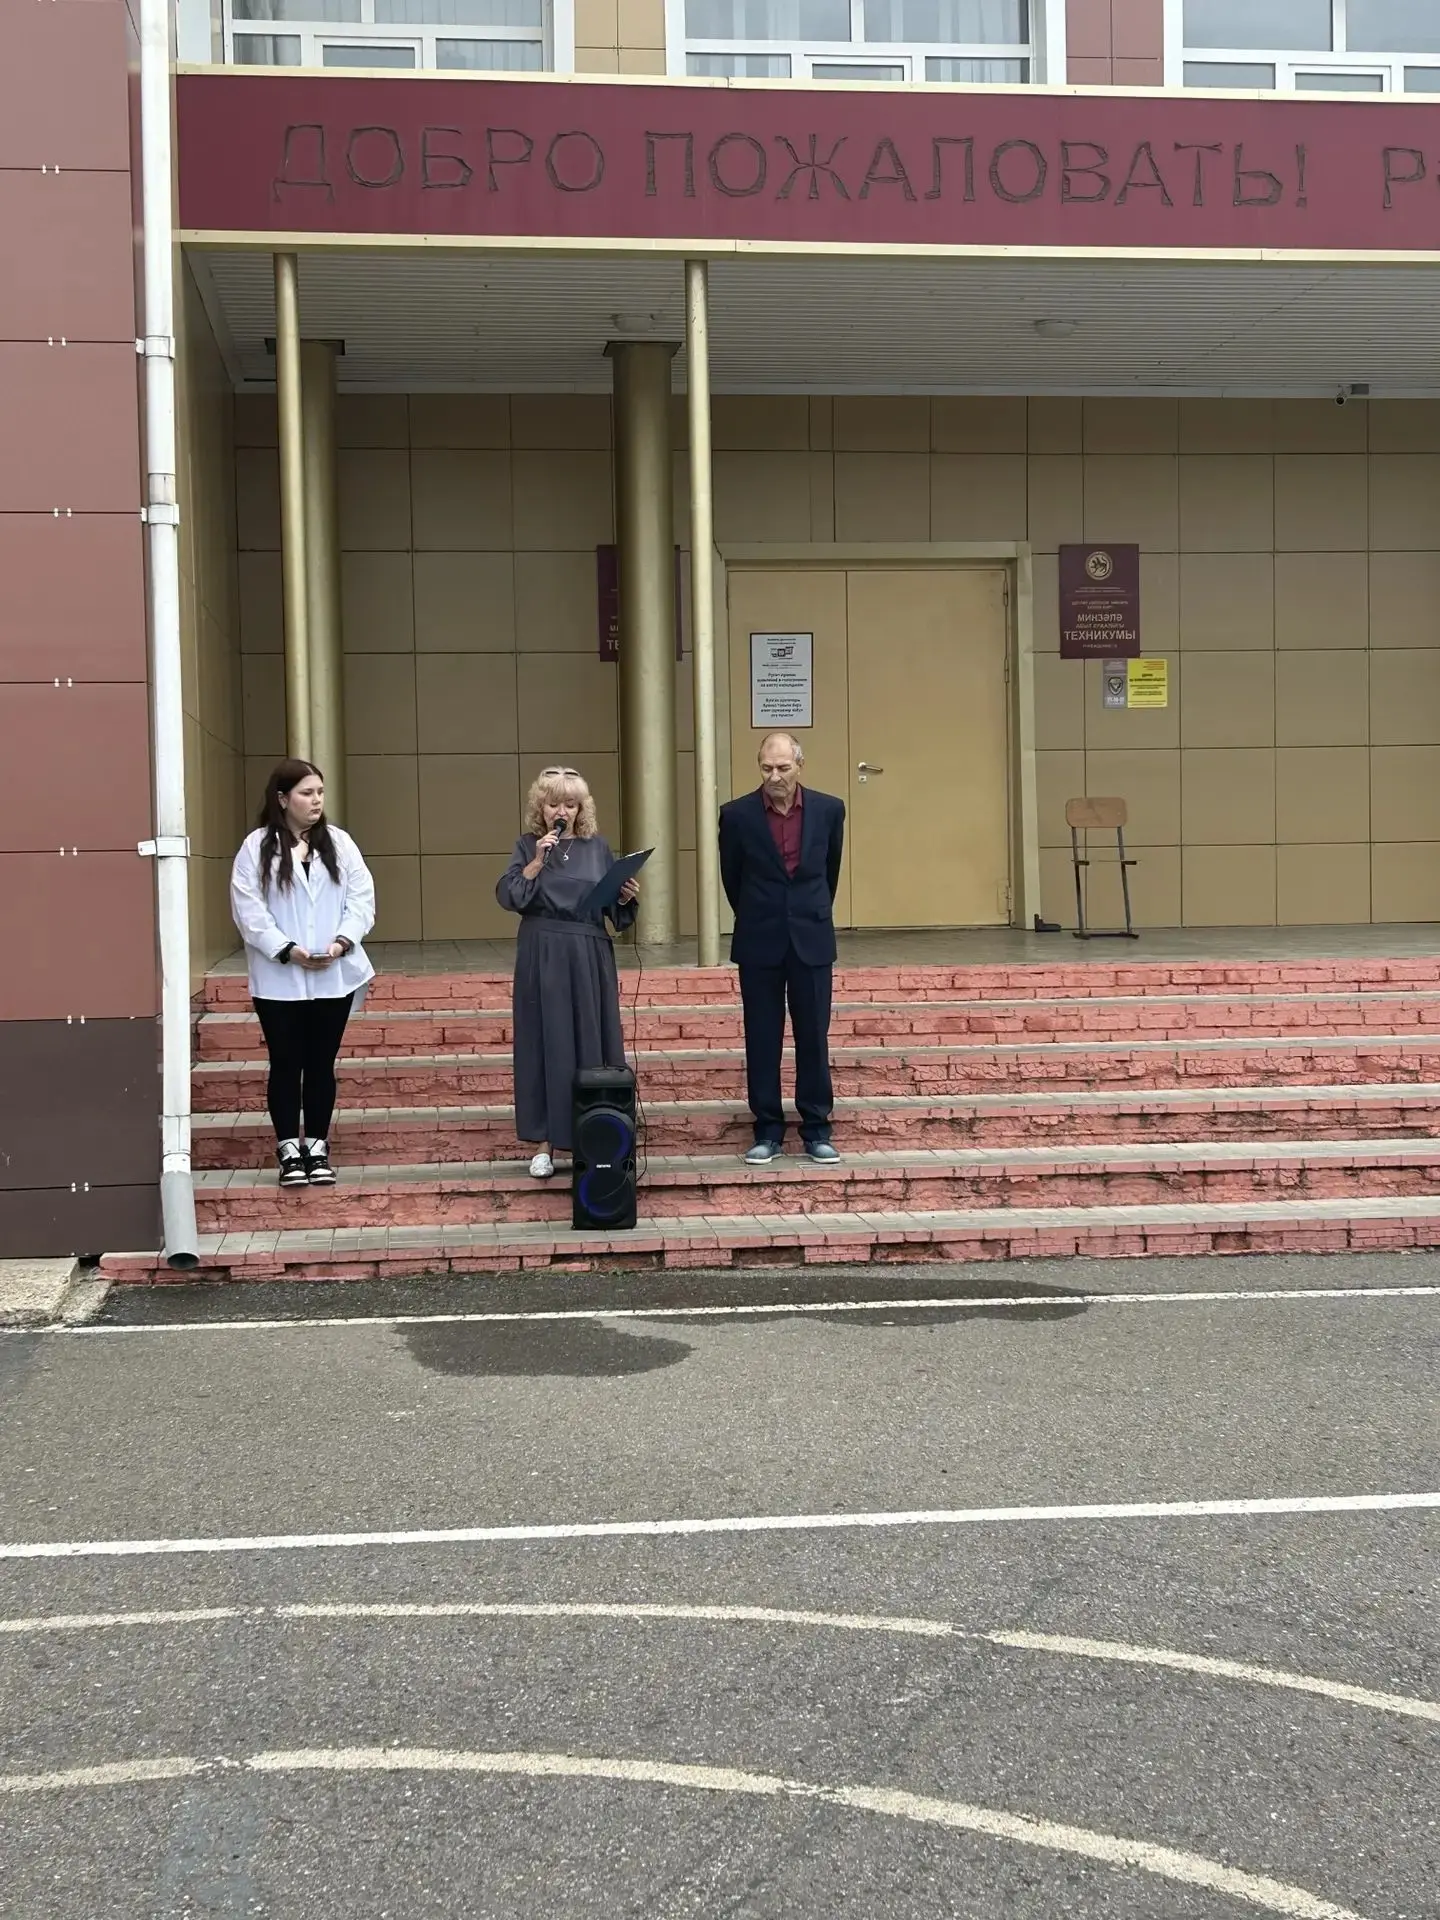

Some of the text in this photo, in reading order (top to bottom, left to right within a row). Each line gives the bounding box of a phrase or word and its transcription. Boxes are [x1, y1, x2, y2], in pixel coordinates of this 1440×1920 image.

[271, 123, 1440, 210] ДОБРО ПОЖАЛОВАТЬ! Р
[1064, 630, 1136, 641] ТЕХНИКУМЫ
